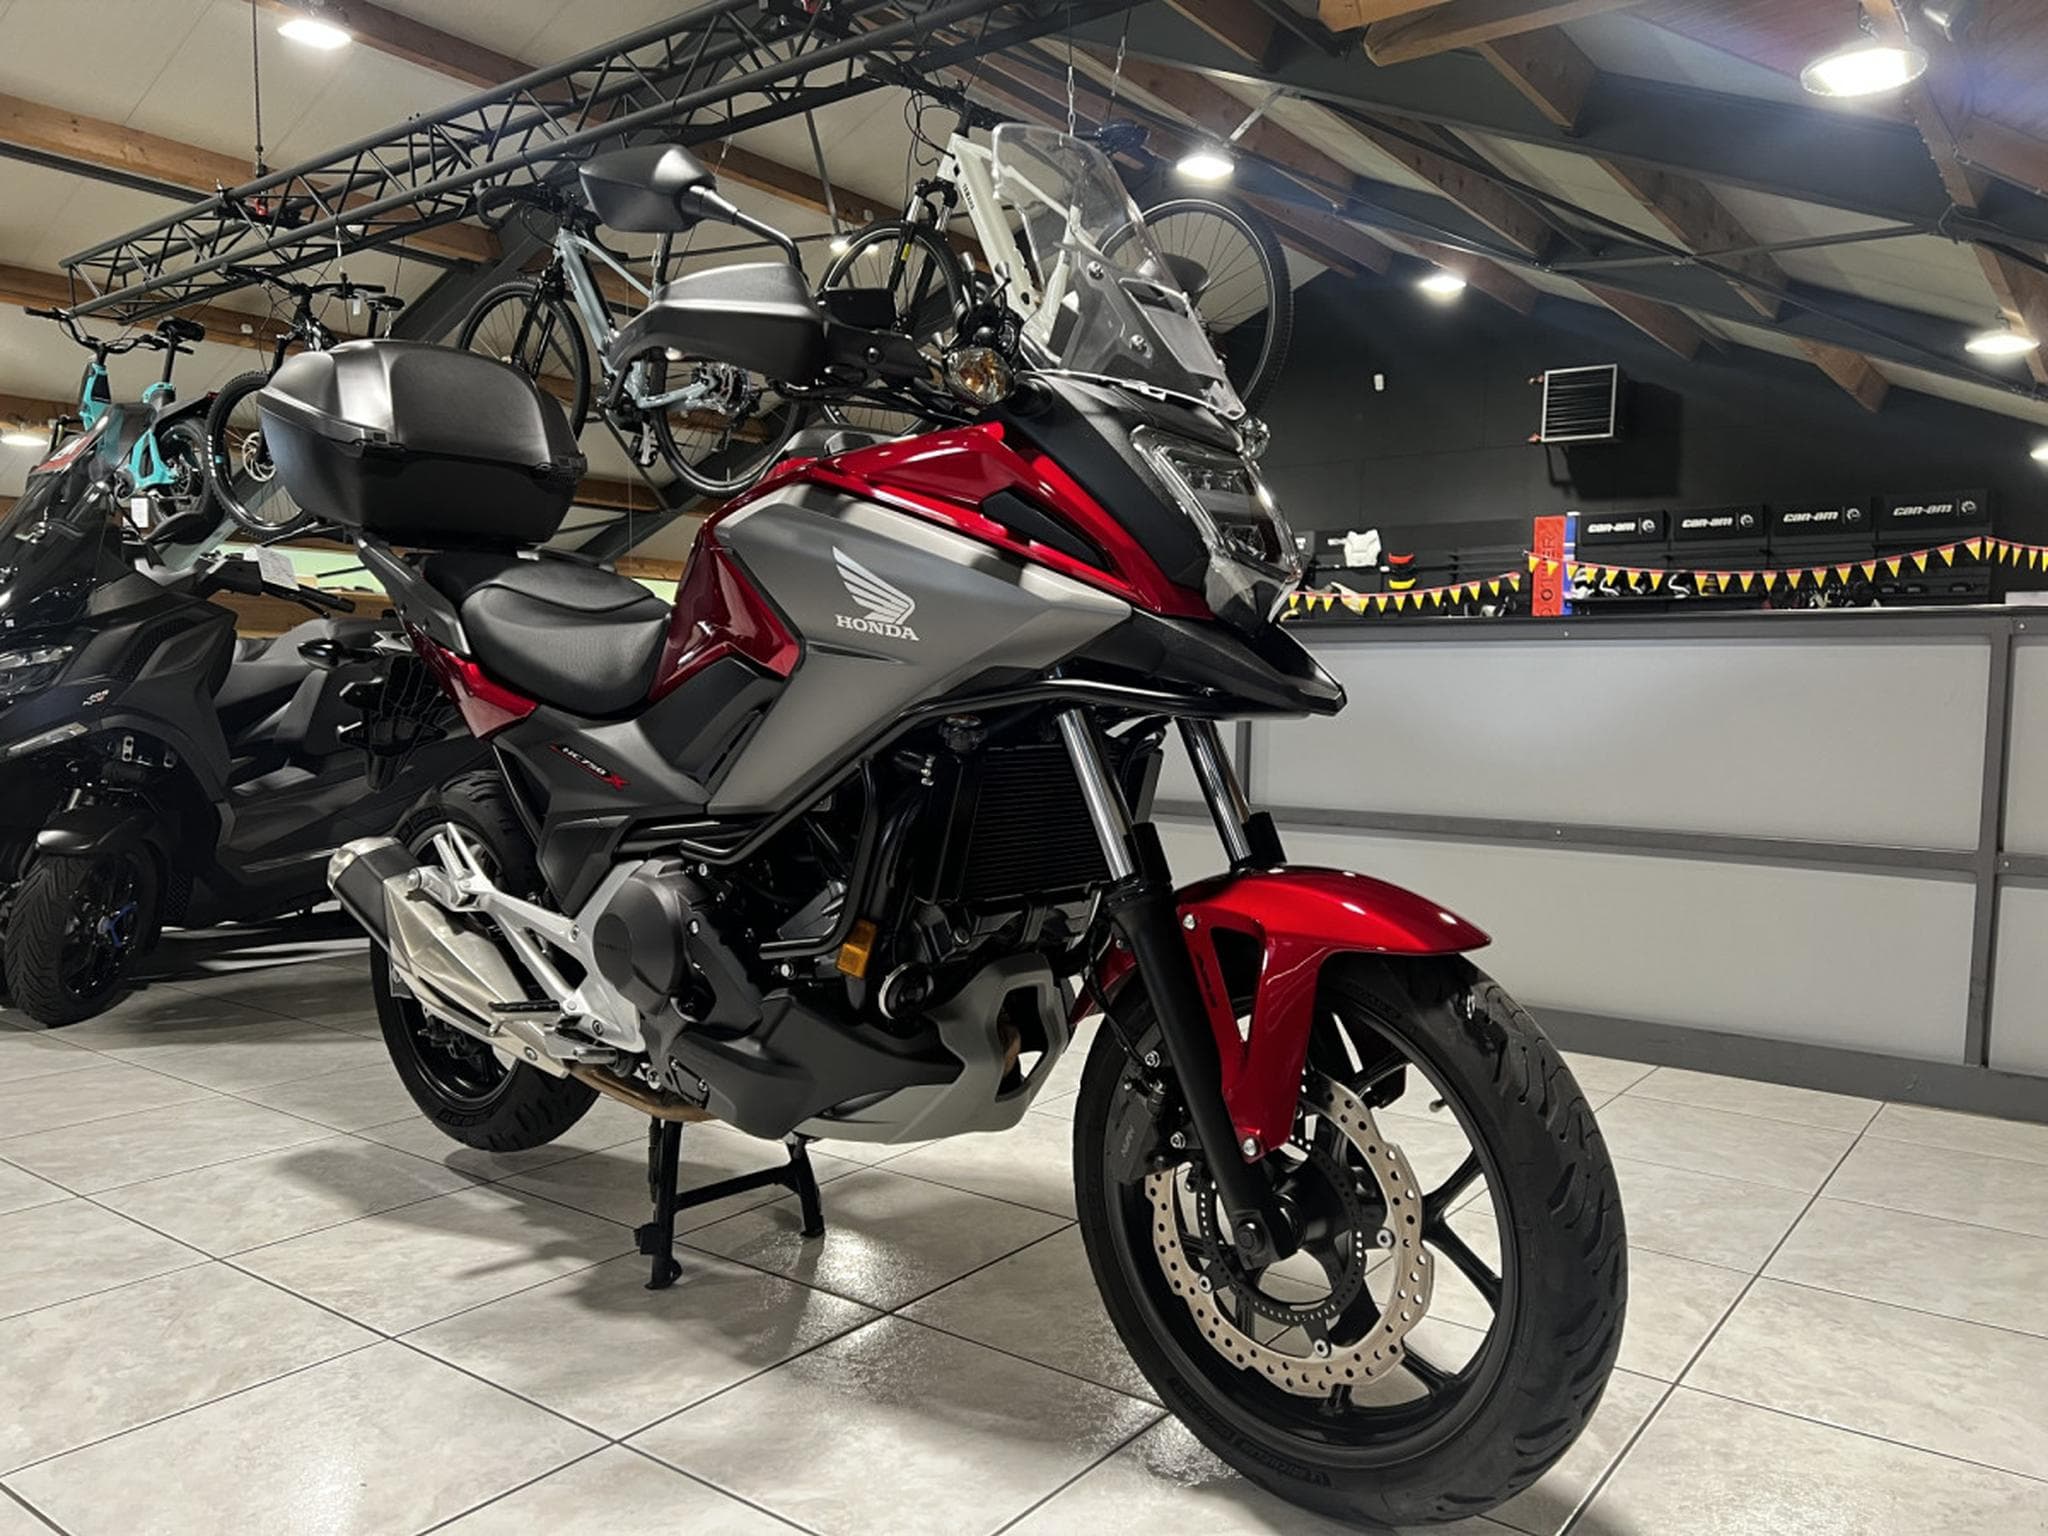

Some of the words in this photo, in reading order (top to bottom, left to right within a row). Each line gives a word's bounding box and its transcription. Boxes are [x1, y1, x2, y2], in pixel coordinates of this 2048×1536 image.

[1892, 504, 1953, 516] can-am
[1681, 516, 1734, 529] can-am
[1782, 511, 1839, 523] can-am
[1586, 521, 1637, 534] can-am
[834, 614, 920, 641] HONDA
